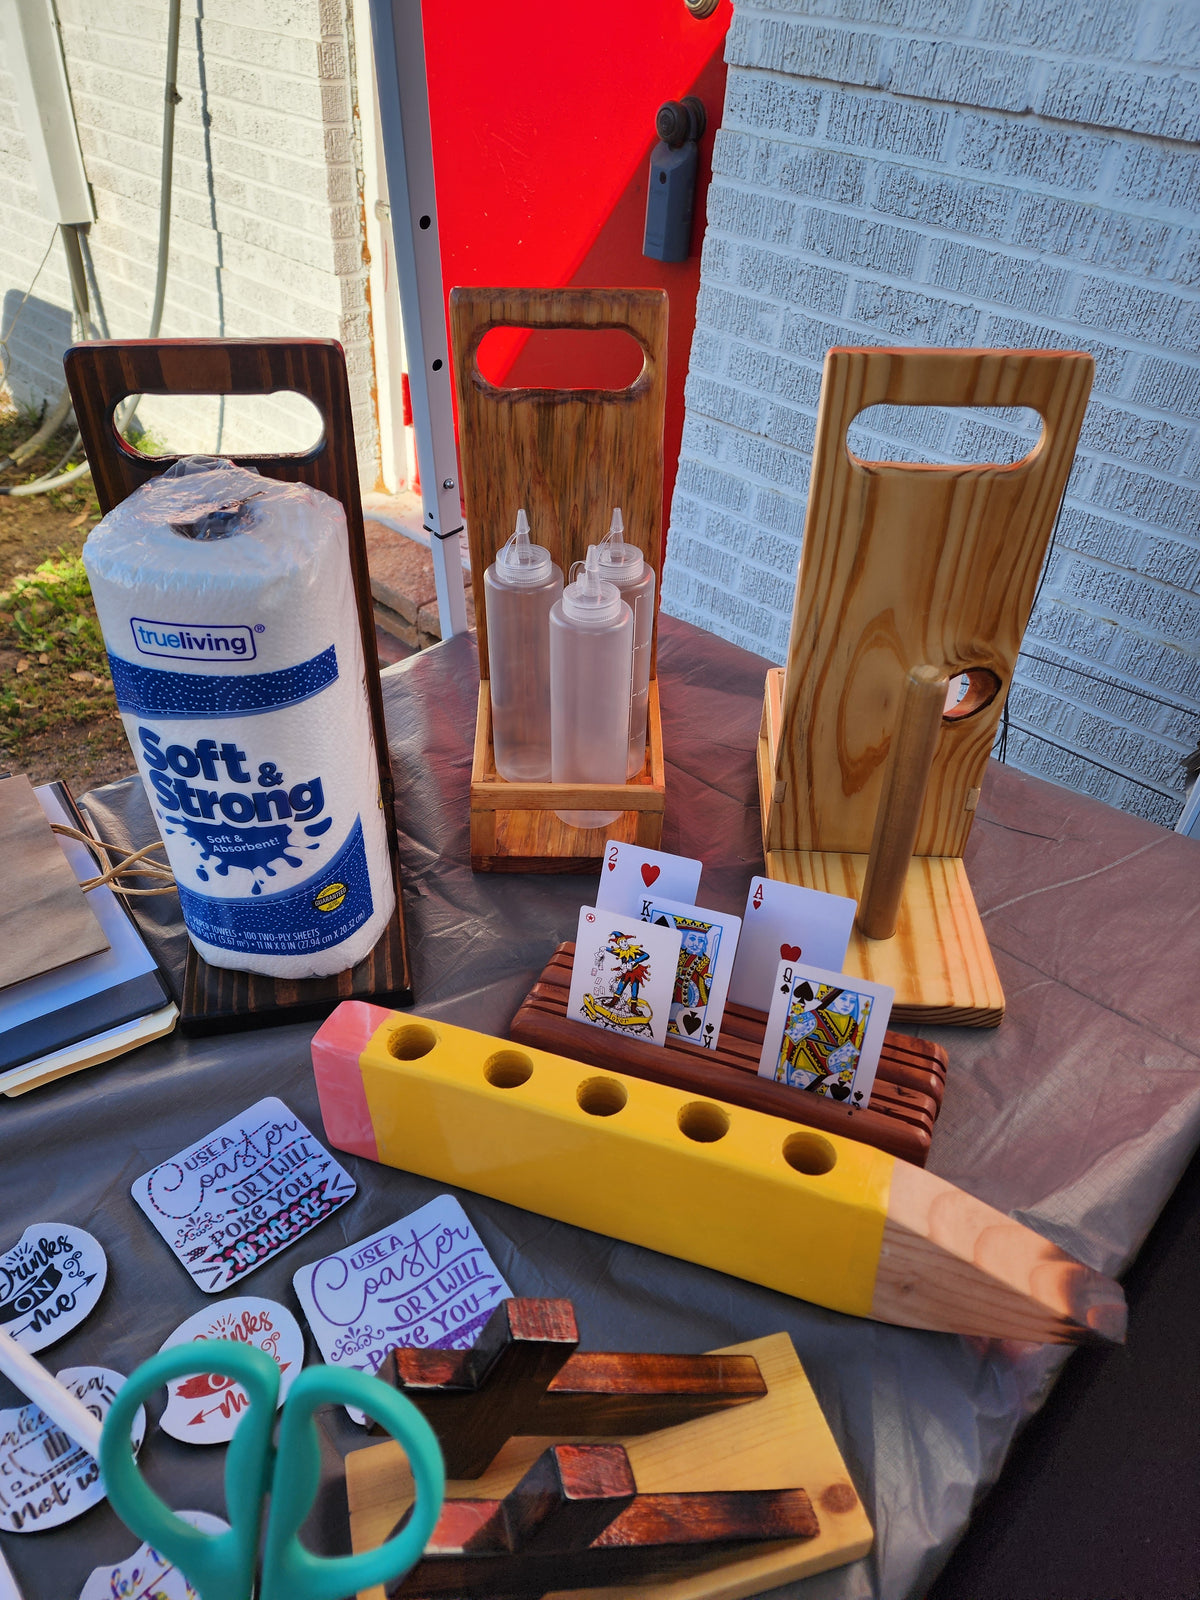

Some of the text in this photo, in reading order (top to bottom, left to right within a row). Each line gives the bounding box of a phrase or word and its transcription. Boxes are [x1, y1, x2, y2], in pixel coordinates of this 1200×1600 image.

[138, 626, 247, 655] trueliving
[138, 726, 284, 787] Soft &
[149, 769, 325, 823] Strong
[206, 834, 244, 844] Soft &
[213, 837, 280, 852] Absorbent!
[608, 846, 619, 862] 2
[314, 887, 347, 907] GUARANTEED
[640, 899, 653, 917] K
[753, 883, 764, 900] A
[210, 924, 237, 938] TOWELS
[243, 930, 257, 941] 100
[257, 931, 291, 942] TWO-PLY
[292, 927, 320, 941] SHEETS
[264, 940, 273, 950] IN
[281, 941, 287, 950] 8
[287, 941, 296, 950] IN
[297, 936, 321, 951] (27.94
[321, 934, 333, 944] cm
[339, 919, 356, 936] 20.32
[782, 967, 792, 983] Q
[148, 1120, 297, 1219] Coaster
[183, 1136, 235, 1172] USE A
[231, 1143, 314, 1206] OR I WILL
[267, 1171, 313, 1208] YOU
[230, 1195, 326, 1268] IN THE EYE
[350, 1235, 404, 1271] USE A
[311, 1222, 470, 1327] Coaster
[394, 1256, 484, 1324] OR I WILL
[13, 1278, 55, 1313] ON
[30, 1292, 77, 1333] me
[430, 1293, 481, 1333] YOU
[11, 1481, 71, 1530] not
